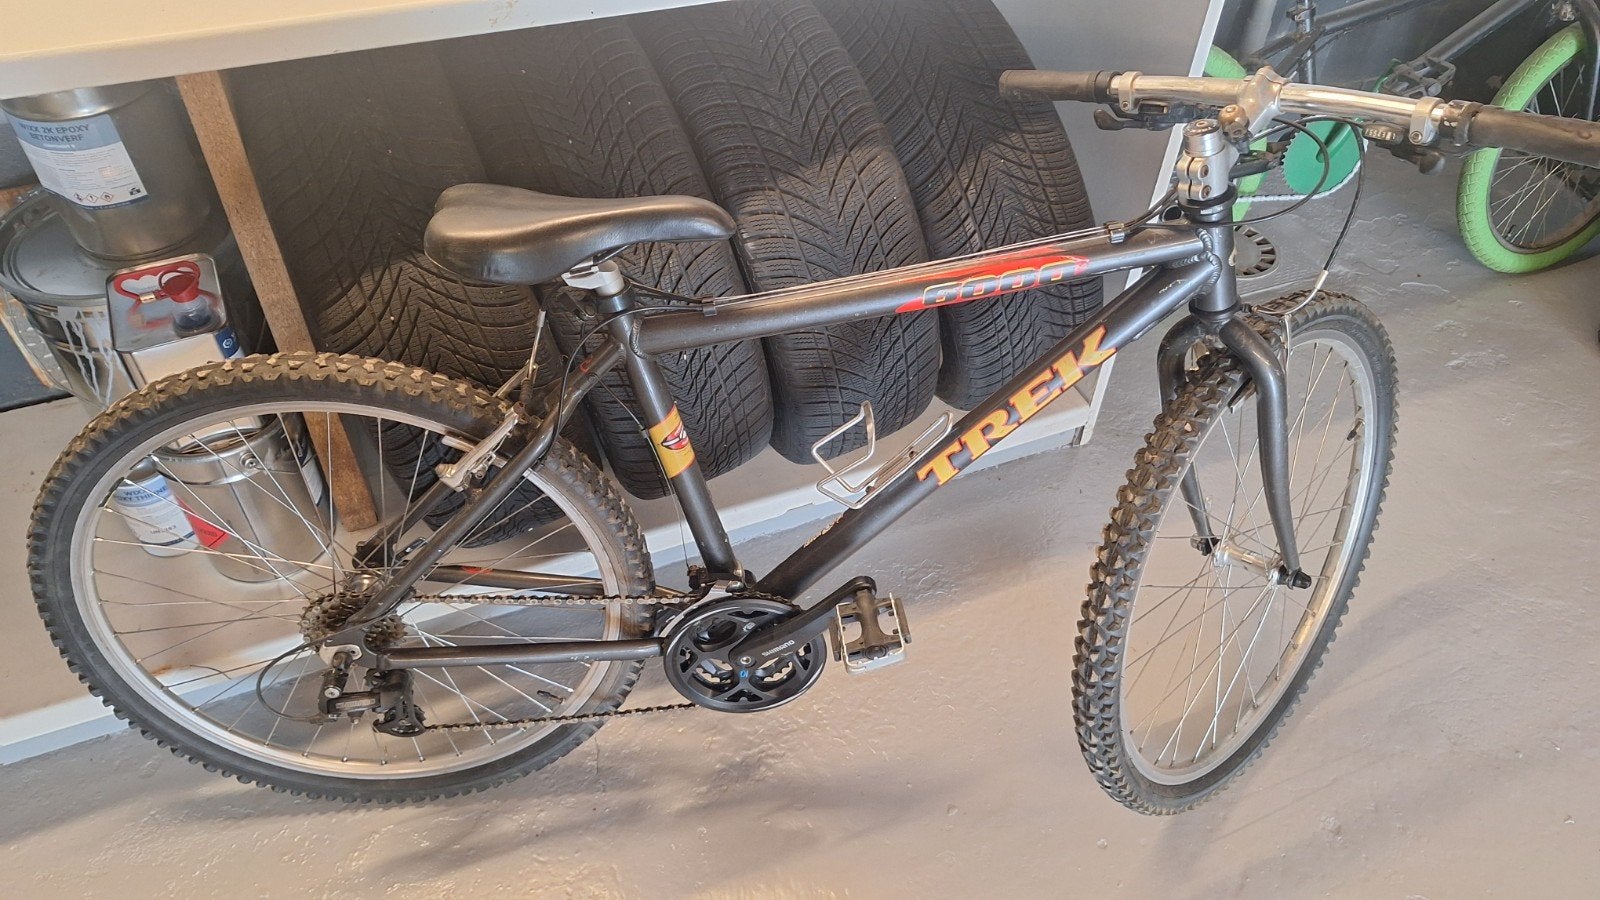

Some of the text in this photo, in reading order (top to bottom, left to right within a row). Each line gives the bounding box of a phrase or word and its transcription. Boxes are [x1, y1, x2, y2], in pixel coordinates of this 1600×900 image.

[43, 126, 54, 134] 2K
[57, 123, 89, 134] EPOXY
[29, 132, 85, 143] BETONVERF
[916, 325, 1117, 486] TREK
[761, 640, 795, 657] SHIMANO
